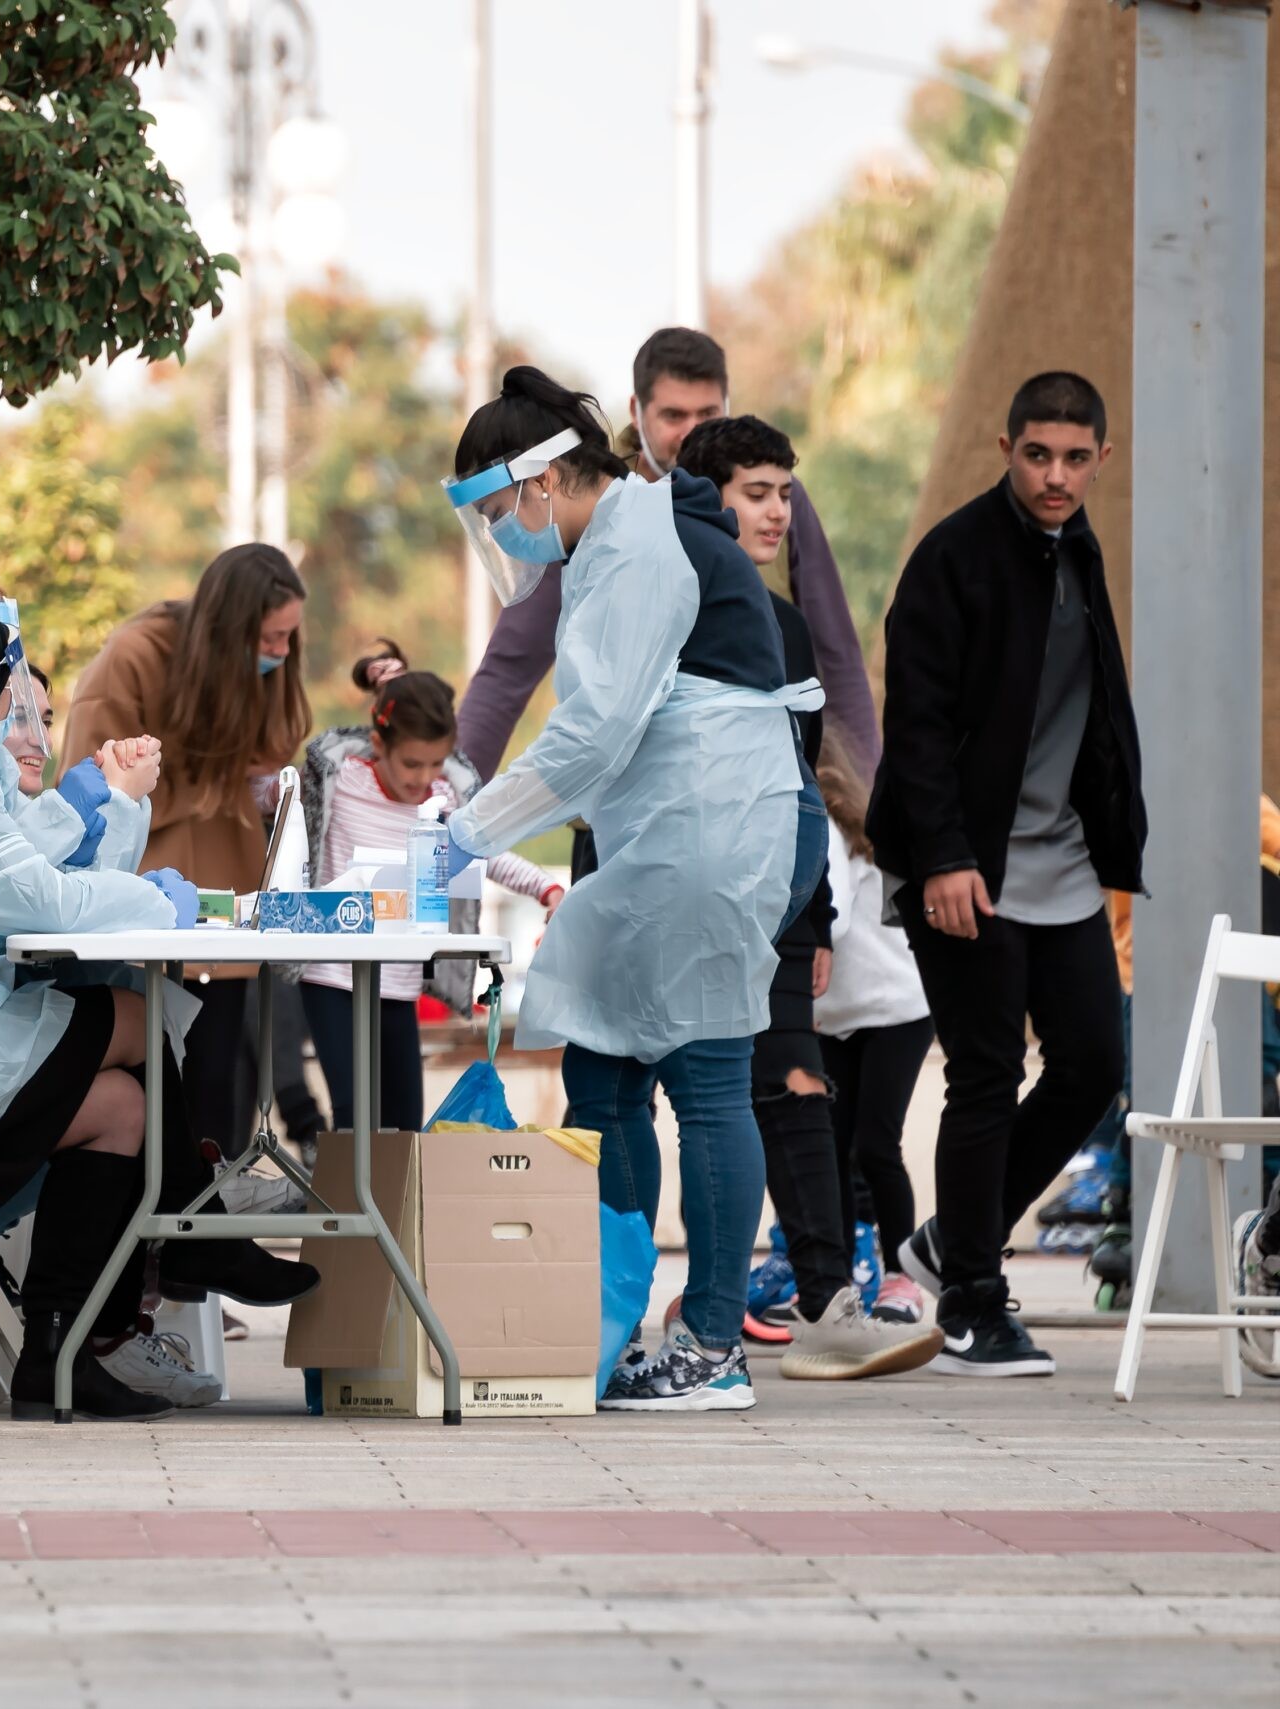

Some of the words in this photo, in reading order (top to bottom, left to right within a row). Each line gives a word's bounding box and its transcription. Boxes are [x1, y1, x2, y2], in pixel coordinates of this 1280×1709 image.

[341, 906, 360, 921] PLUS
[490, 1393, 499, 1401] LP
[500, 1393, 530, 1401] ITALIANA
[531, 1393, 543, 1401] SPA
